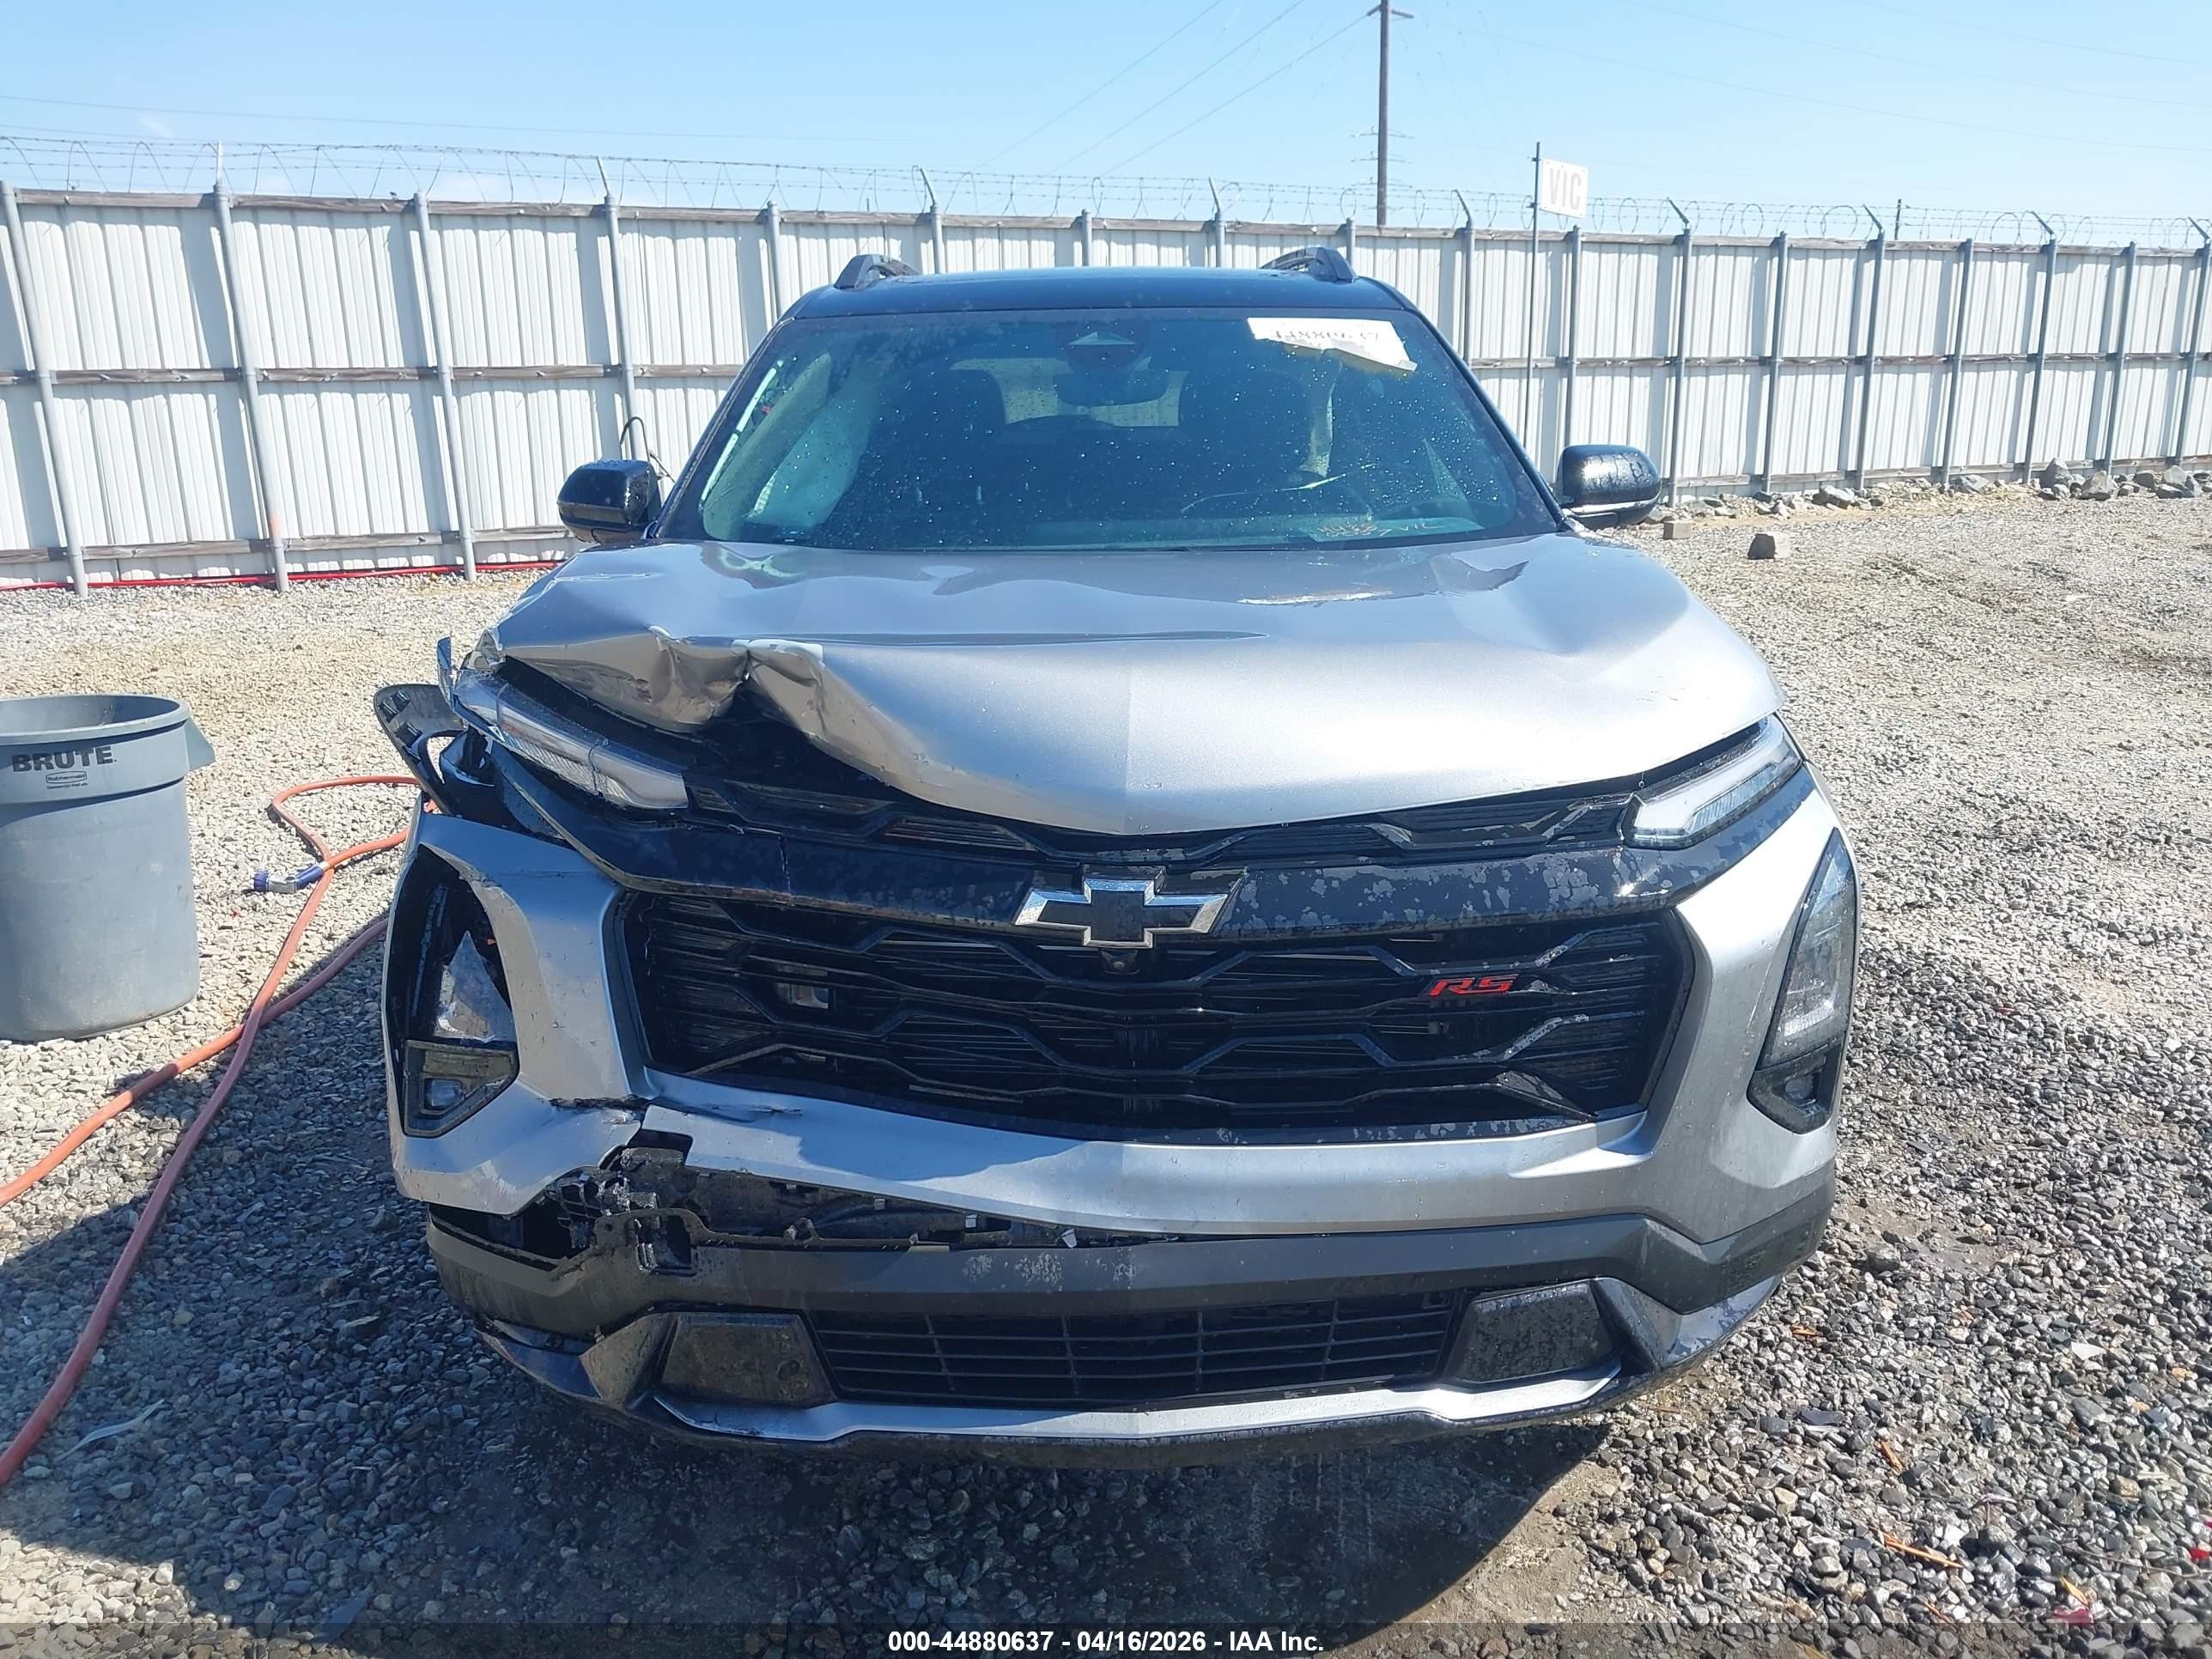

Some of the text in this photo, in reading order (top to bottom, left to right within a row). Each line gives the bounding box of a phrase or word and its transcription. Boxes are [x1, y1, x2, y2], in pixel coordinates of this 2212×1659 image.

[1550, 168, 1581, 210] VIC
[12, 746, 113, 772] BRUTE
[1430, 974, 1518, 996] RS
